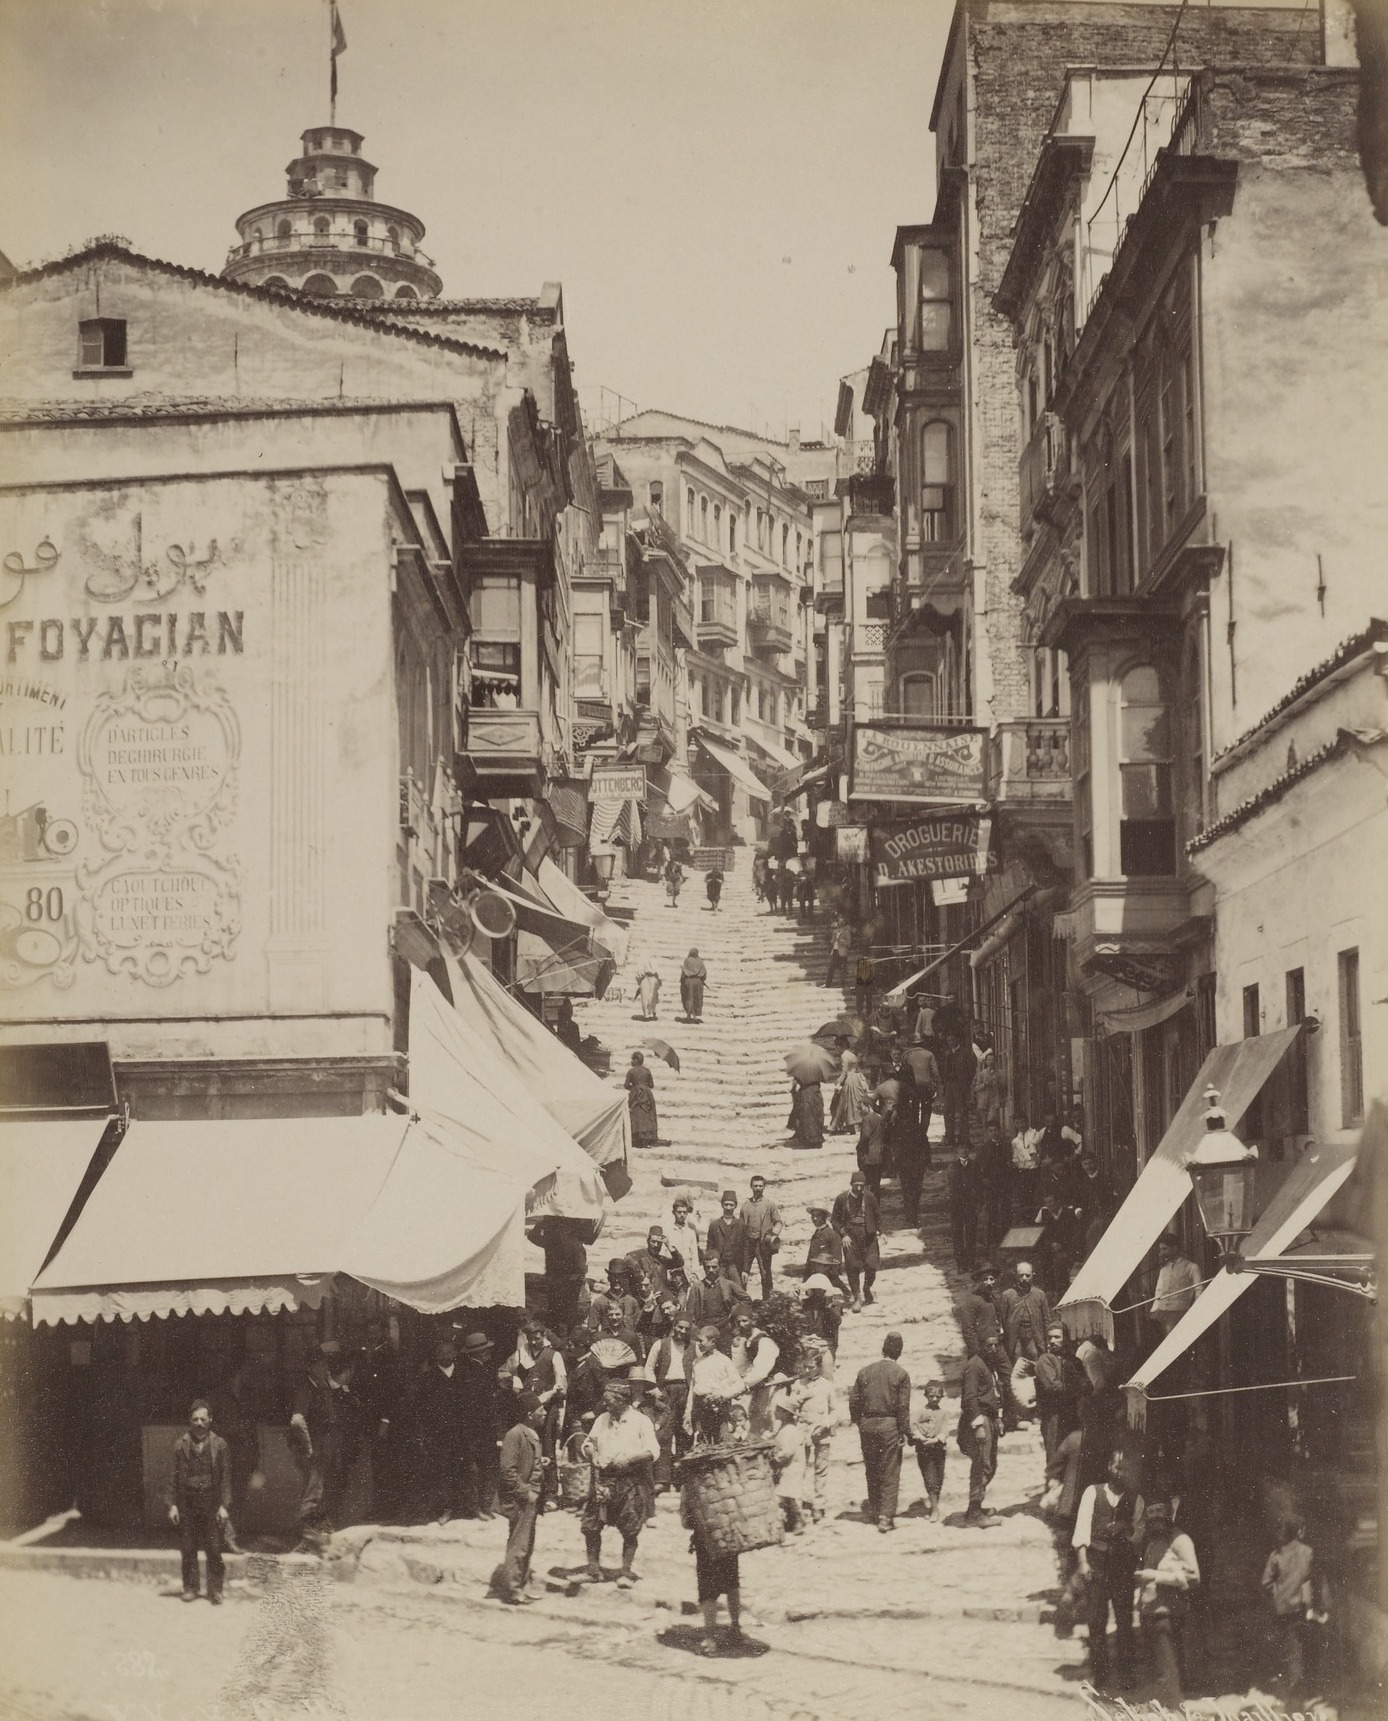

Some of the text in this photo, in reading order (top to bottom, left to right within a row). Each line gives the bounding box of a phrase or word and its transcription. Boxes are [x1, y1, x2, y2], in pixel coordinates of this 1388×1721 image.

[7, 611, 245, 664] FOYAGIAN
[0, 719, 64, 755] LITÉ
[108, 764, 220, 784] EN TOUS GENRES
[898, 850, 998, 877] AKESTORIDS
[26, 886, 63, 922] 80
[111, 896, 184, 915] OPTIQUES
[111, 914, 212, 931] LUNETTERIES
